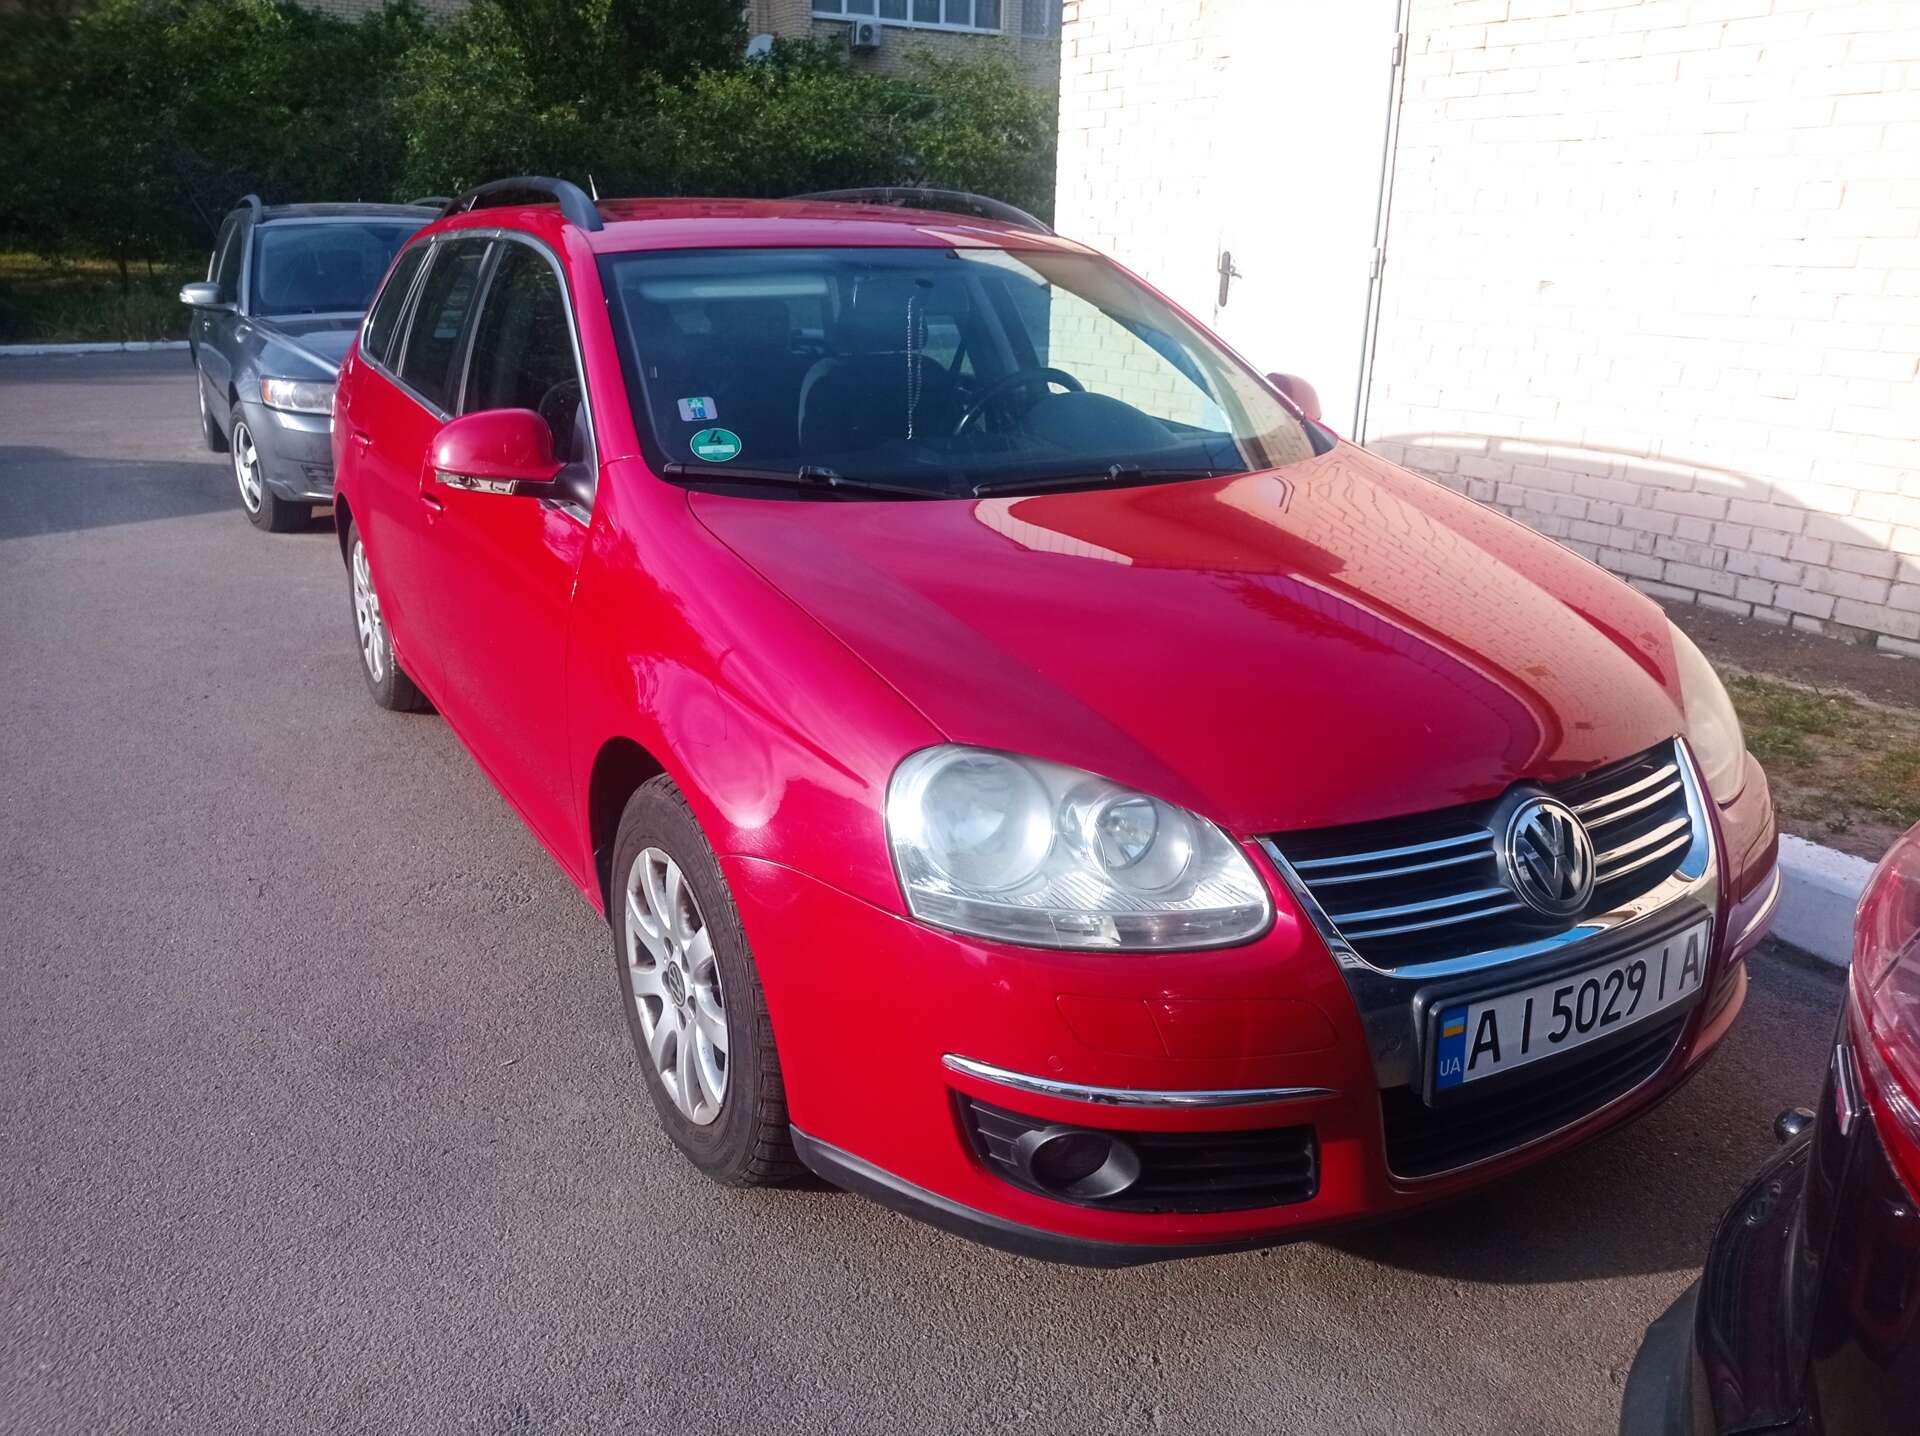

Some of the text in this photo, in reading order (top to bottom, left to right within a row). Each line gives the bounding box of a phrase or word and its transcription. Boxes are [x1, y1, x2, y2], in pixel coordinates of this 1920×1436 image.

[707, 430, 723, 445] 4
[1467, 931, 1700, 1071] AI 5029 IA
[1439, 1057, 1461, 1077] UA
